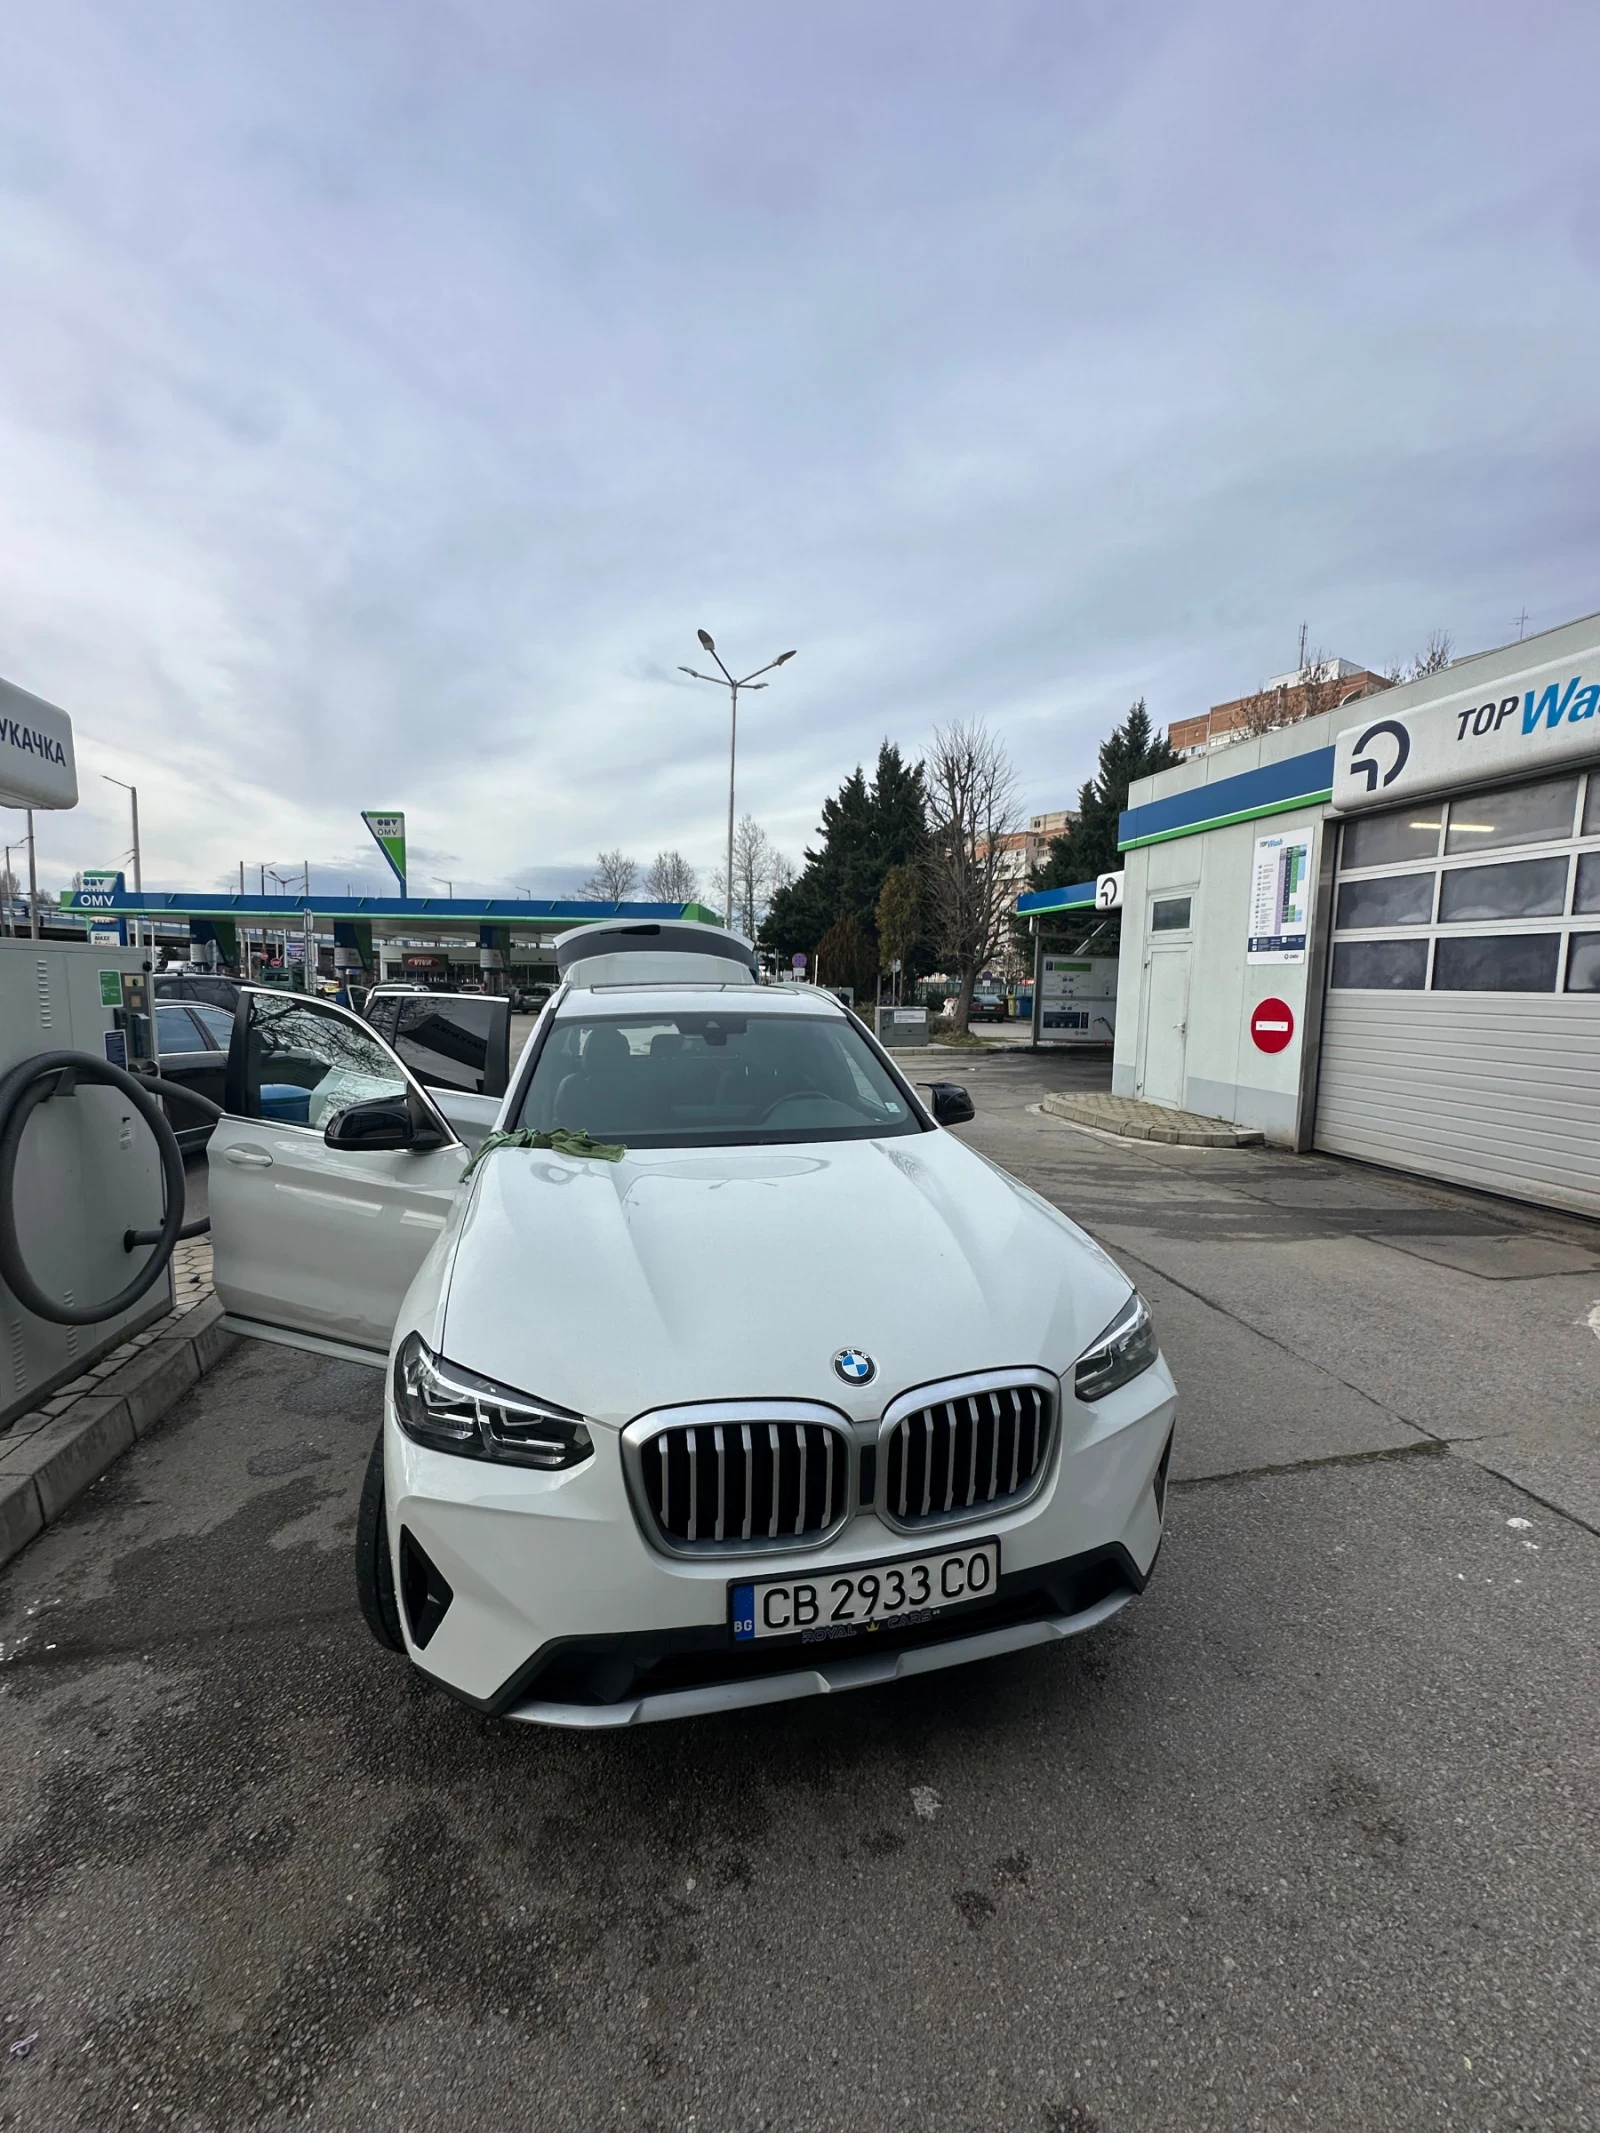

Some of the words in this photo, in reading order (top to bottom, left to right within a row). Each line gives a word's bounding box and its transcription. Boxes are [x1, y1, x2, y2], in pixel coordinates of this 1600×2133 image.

[1457, 676, 1600, 741] TOPWa
[0, 717, 67, 767] УКАЧКА
[377, 828, 398, 836] OMV
[80, 894, 115, 907] OMV
[836, 1349, 869, 1362] BMW
[763, 1584, 820, 1629] CB
[830, 1564, 931, 1622] 2933
[941, 1552, 990, 1598] CO
[734, 1619, 753, 1633] BG
[802, 1623, 857, 1644] ROYAL
[887, 1609, 932, 1629] CARS
